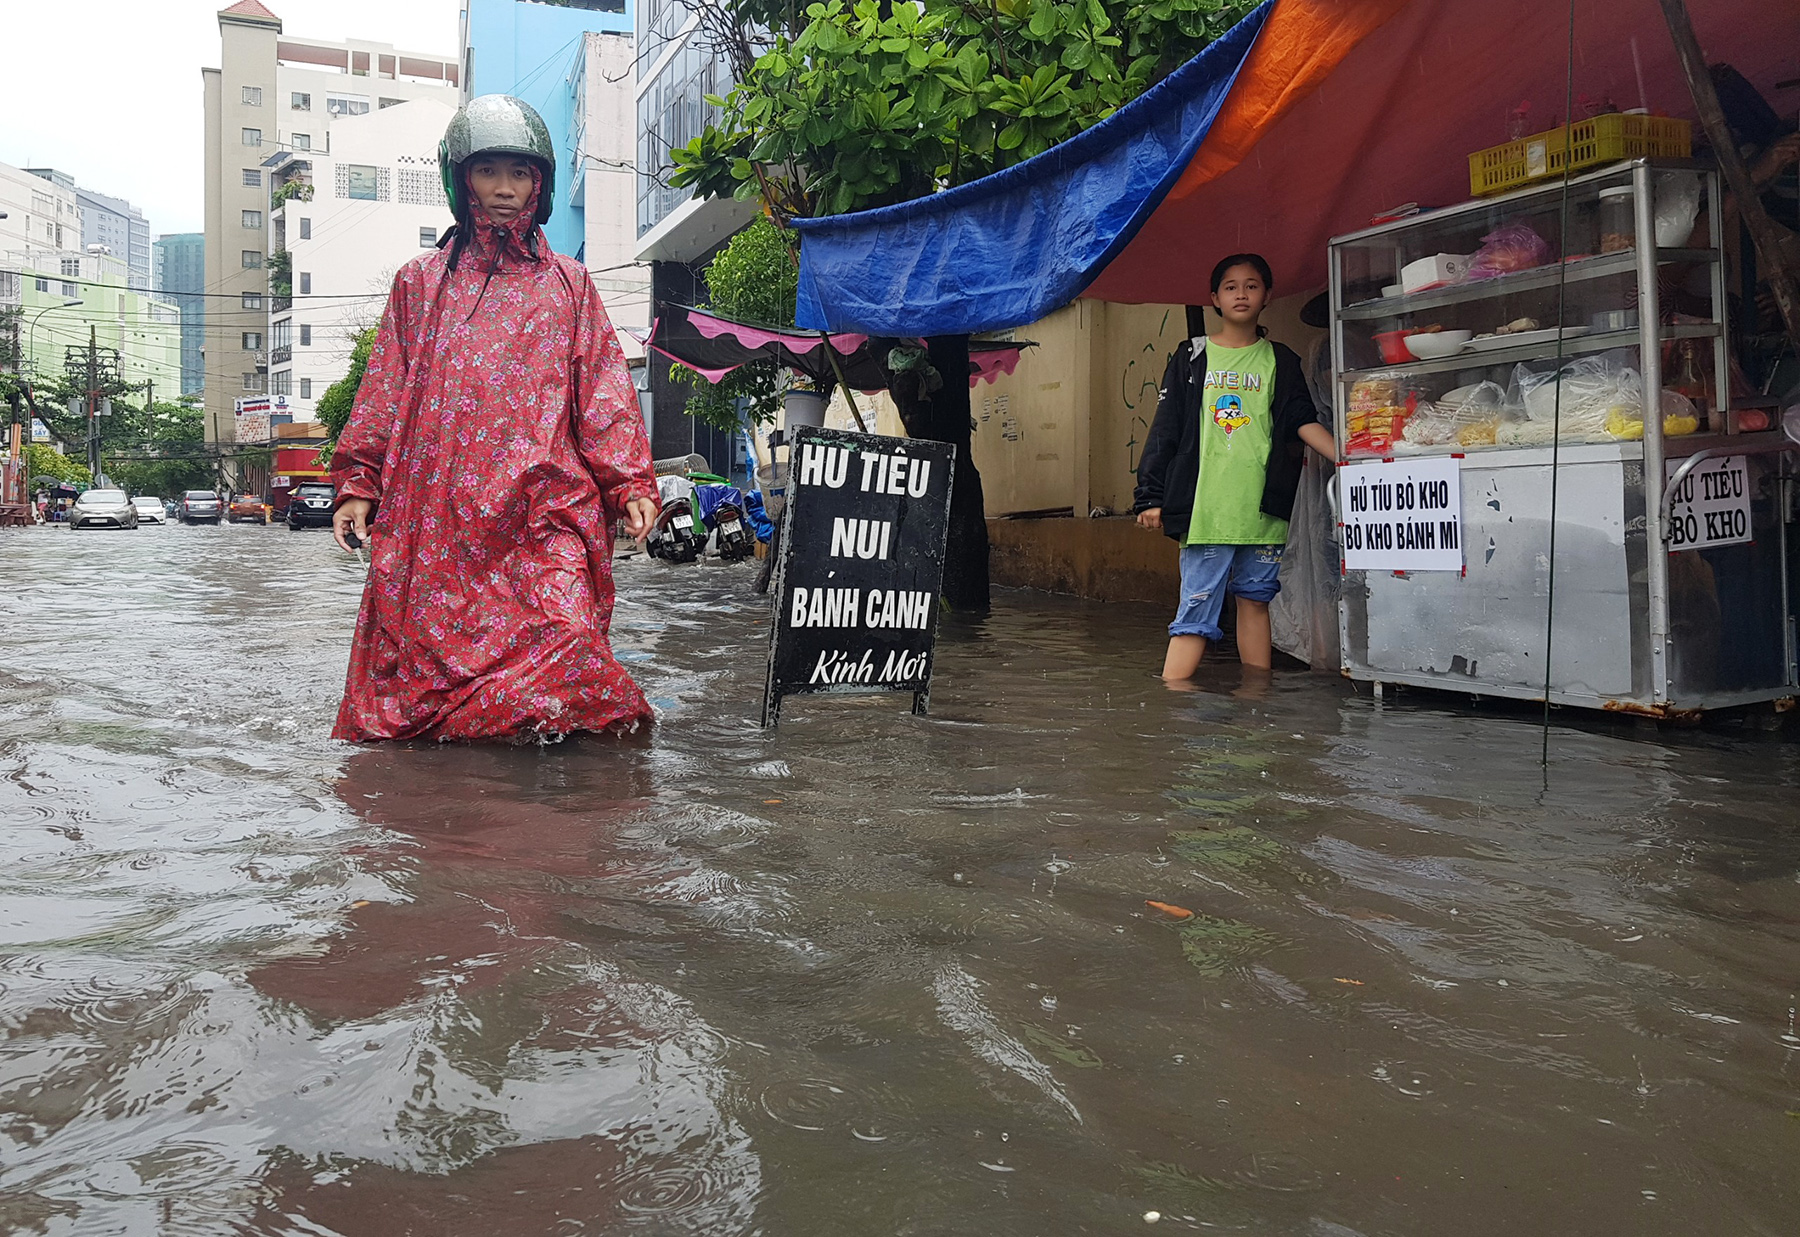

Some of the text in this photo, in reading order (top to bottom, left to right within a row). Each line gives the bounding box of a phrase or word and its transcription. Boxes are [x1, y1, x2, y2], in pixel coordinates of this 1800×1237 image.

[1242, 371, 1261, 392] IN
[800, 443, 931, 498] HU TIÊU
[1700, 456, 1743, 501] TIẾU
[1350, 475, 1449, 512] HỦ TÍU BÒ KHO
[830, 517, 892, 560] NUI
[1345, 515, 1459, 550] BÒ KHO BÁNH MÌ
[1672, 505, 1747, 545] BÒ KHO
[791, 571, 932, 630] BÁNH CANH
[809, 648, 874, 684] Kính
